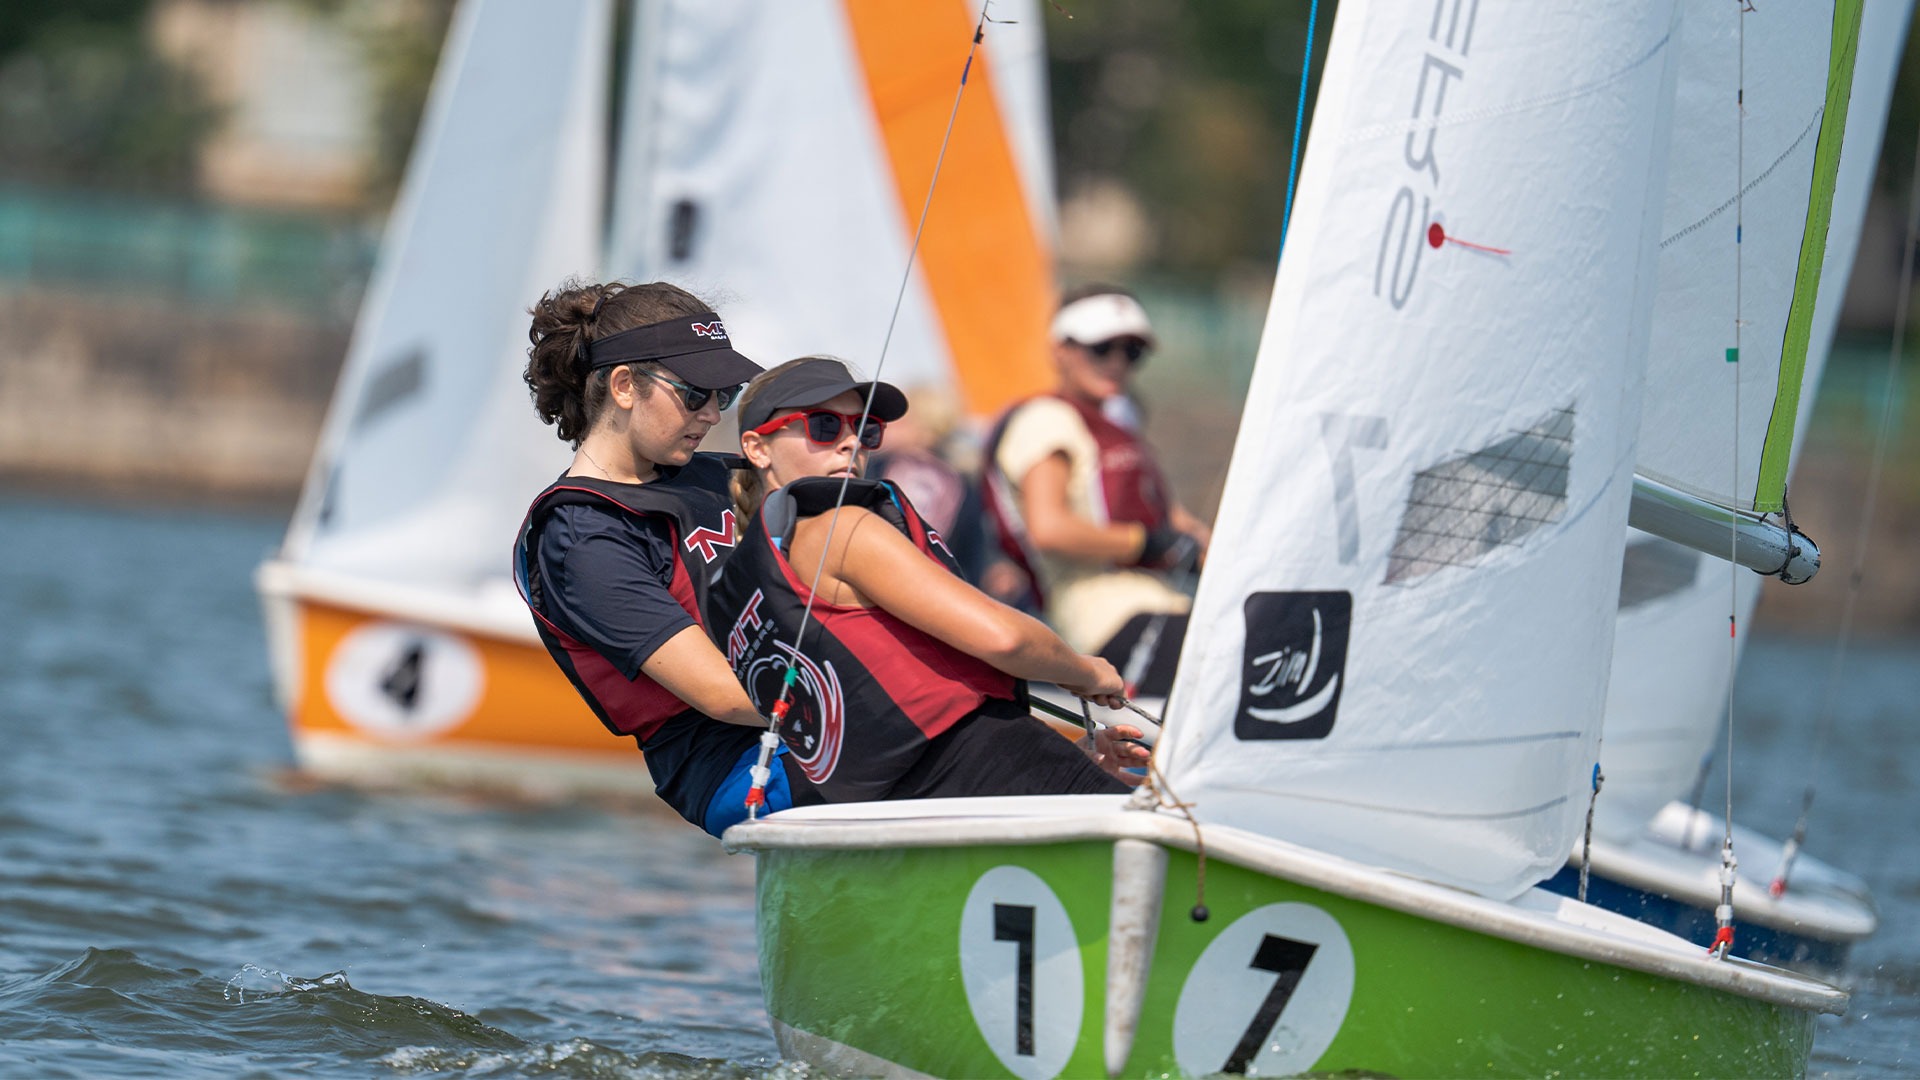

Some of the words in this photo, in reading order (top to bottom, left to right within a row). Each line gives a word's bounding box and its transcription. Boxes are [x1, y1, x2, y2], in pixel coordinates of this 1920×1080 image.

[377, 640, 424, 713] 4
[993, 903, 1036, 1056] 1
[1220, 932, 1320, 1076] 7
